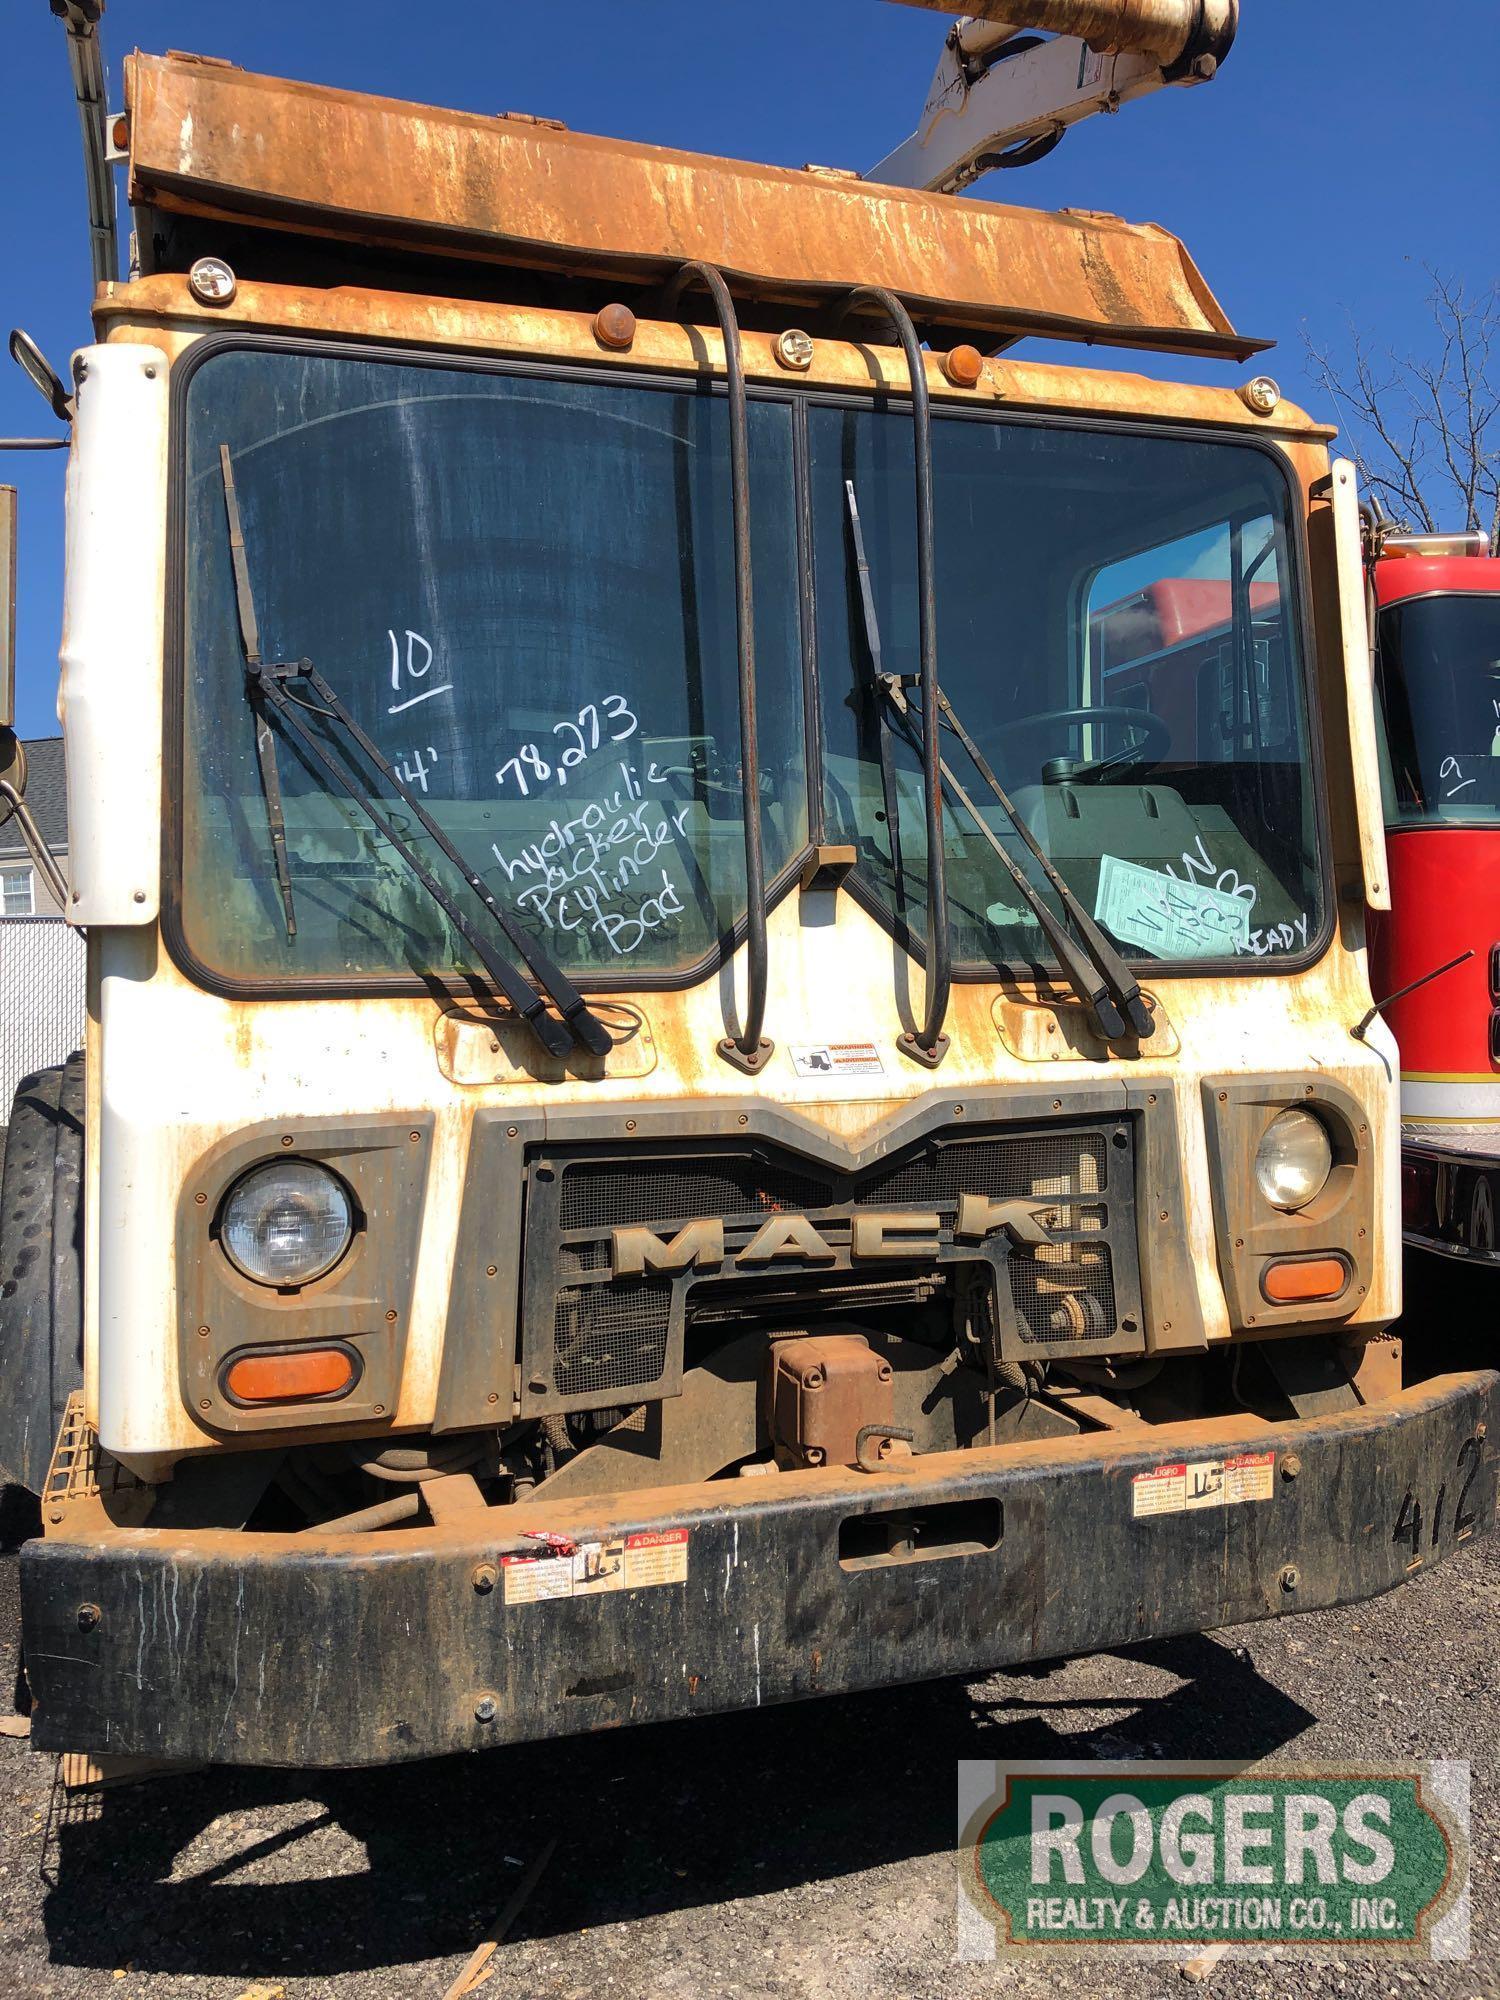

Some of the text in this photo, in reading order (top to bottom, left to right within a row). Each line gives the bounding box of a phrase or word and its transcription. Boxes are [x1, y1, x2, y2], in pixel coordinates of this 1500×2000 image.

[388, 629, 434, 691] 10
[495, 694, 638, 796] 78,273
[591, 868, 686, 955] Bad
[1232, 912, 1308, 957] READY
[611, 1192, 1061, 1277] MACK
[1392, 1437, 1481, 1555] 412
[642, 1533, 682, 1546] DANGER
